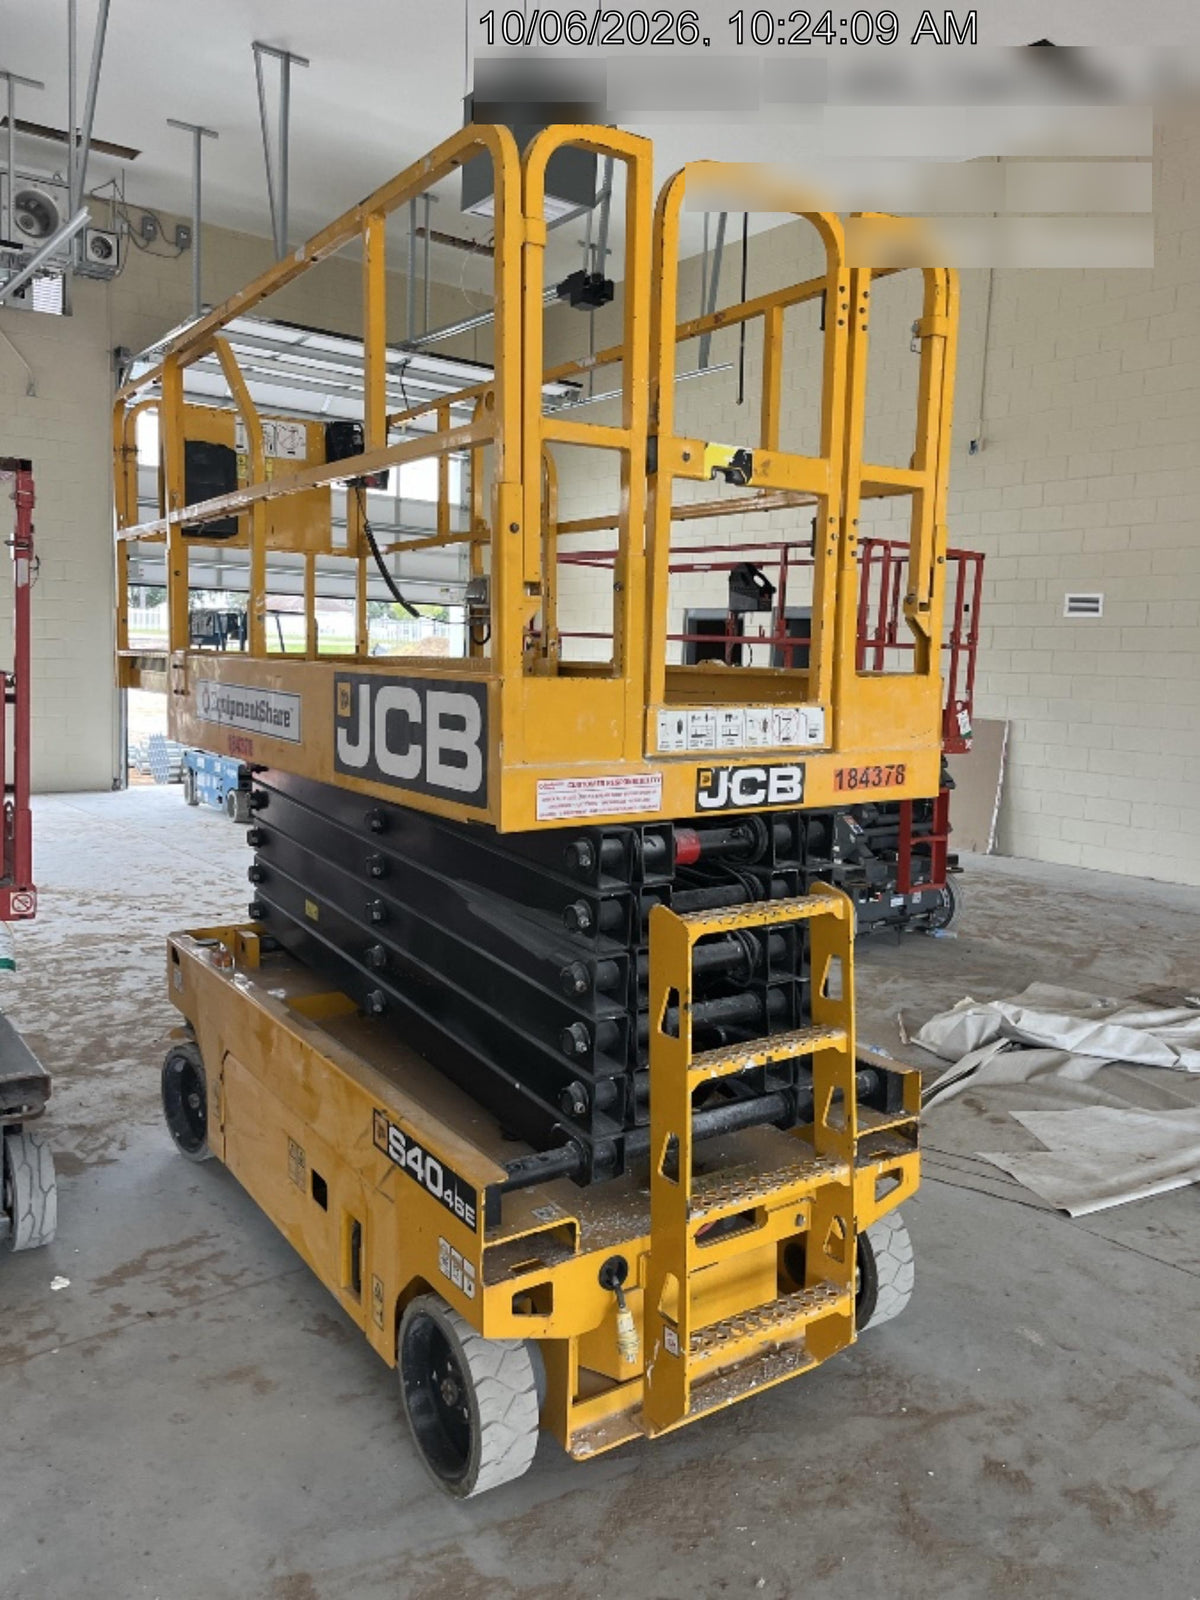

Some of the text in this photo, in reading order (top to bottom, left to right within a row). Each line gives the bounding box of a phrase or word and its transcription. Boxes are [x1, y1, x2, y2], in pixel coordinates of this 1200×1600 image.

[210, 690, 291, 728] EquipmentShare
[337, 683, 483, 793] JCB
[697, 766, 802, 808] JCB
[835, 764, 906, 791] 184378
